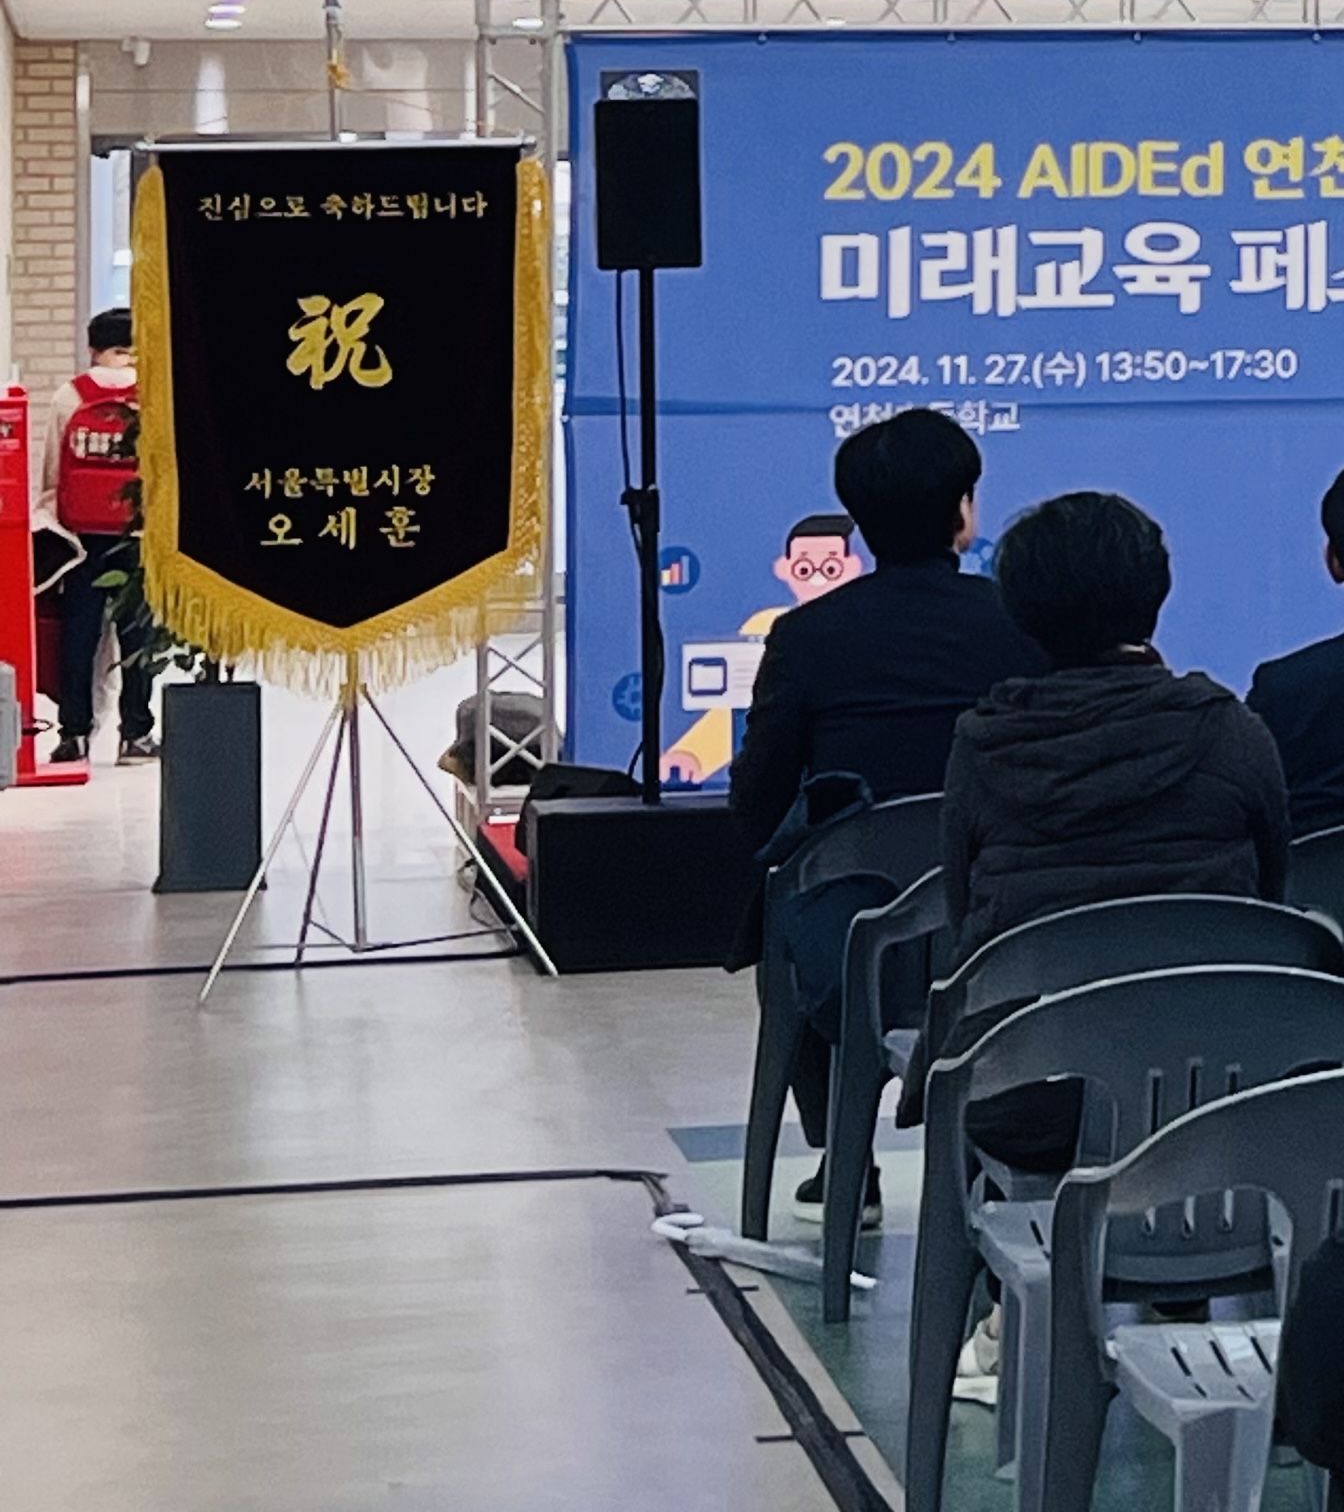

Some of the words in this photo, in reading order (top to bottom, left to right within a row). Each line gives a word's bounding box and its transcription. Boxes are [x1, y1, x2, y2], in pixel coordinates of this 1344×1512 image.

[823, 141, 1002, 201] 2024
[1017, 139, 1225, 199] AIDEd
[198, 193, 311, 221] 진심으로
[320, 190, 488, 221] 축하드립니다
[819, 224, 1212, 319] 미래교육
[286, 292, 393, 390] 祝
[831, 356, 930, 387] 2024.
[937, 355, 976, 386] 11.
[1096, 348, 1299, 383] 13:50~17:30
[244, 464, 436, 499] 서울특별시장
